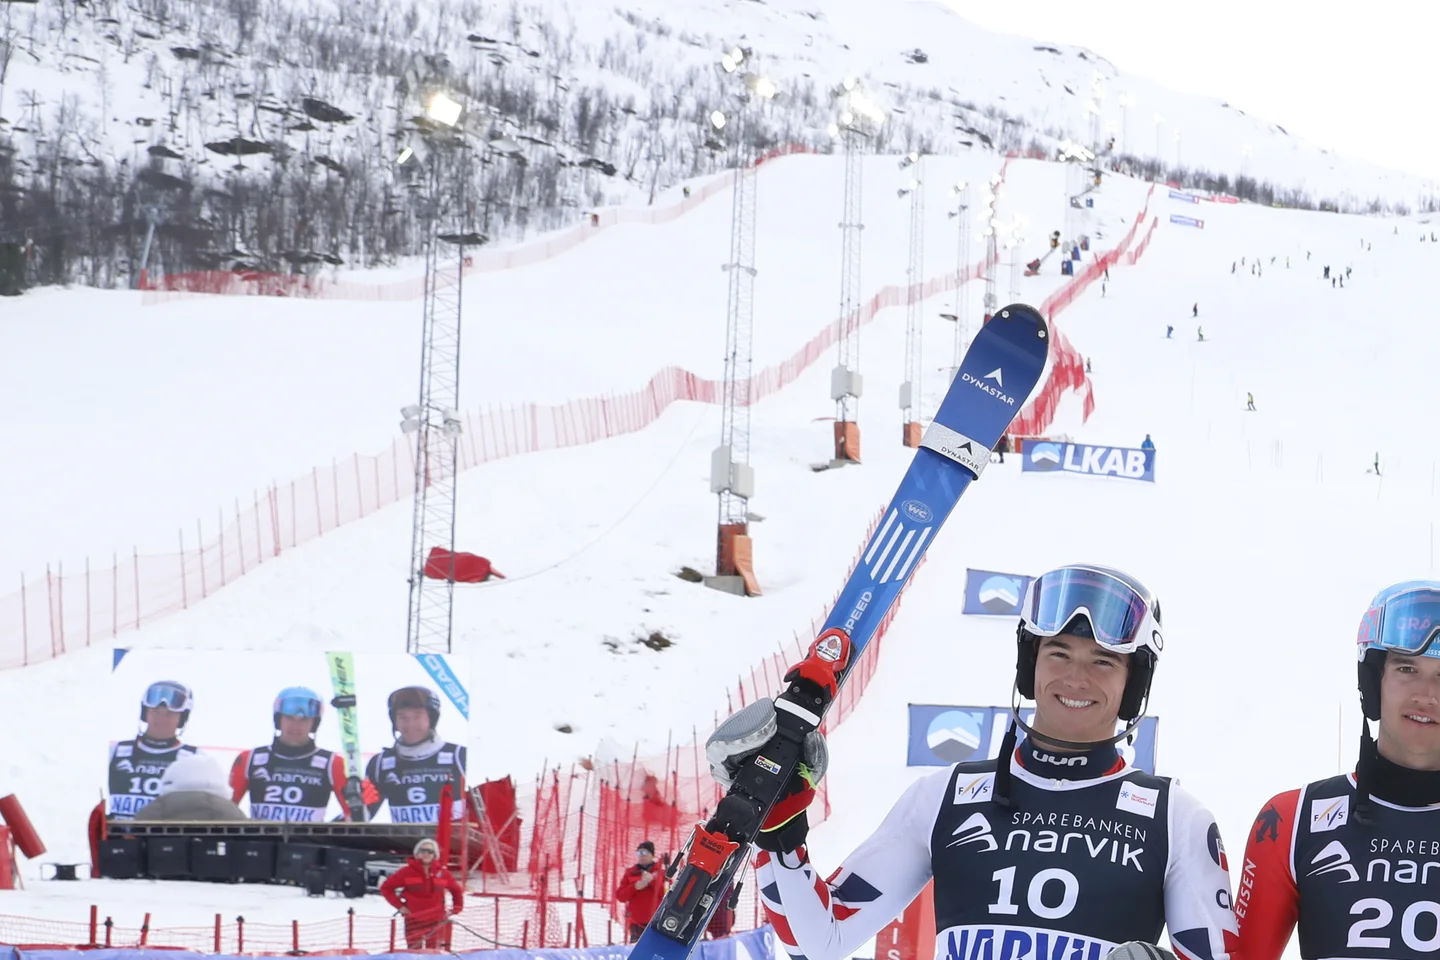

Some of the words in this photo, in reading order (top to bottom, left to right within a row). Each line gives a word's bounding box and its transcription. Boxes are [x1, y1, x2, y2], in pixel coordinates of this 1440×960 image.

[961, 373, 1014, 406] DYNASTAR
[941, 446, 979, 471] DYNASTAR
[1063, 444, 1146, 478] LKAB
[908, 505, 927, 519] WC
[756, 760, 771, 771] LOOK
[128, 777, 161, 795] 10
[264, 785, 304, 804] 20
[407, 786, 426, 803] 6
[1012, 812, 1147, 842] SPAREBANKEN
[1005, 829, 1144, 872] narvik
[988, 866, 1080, 919] 10
